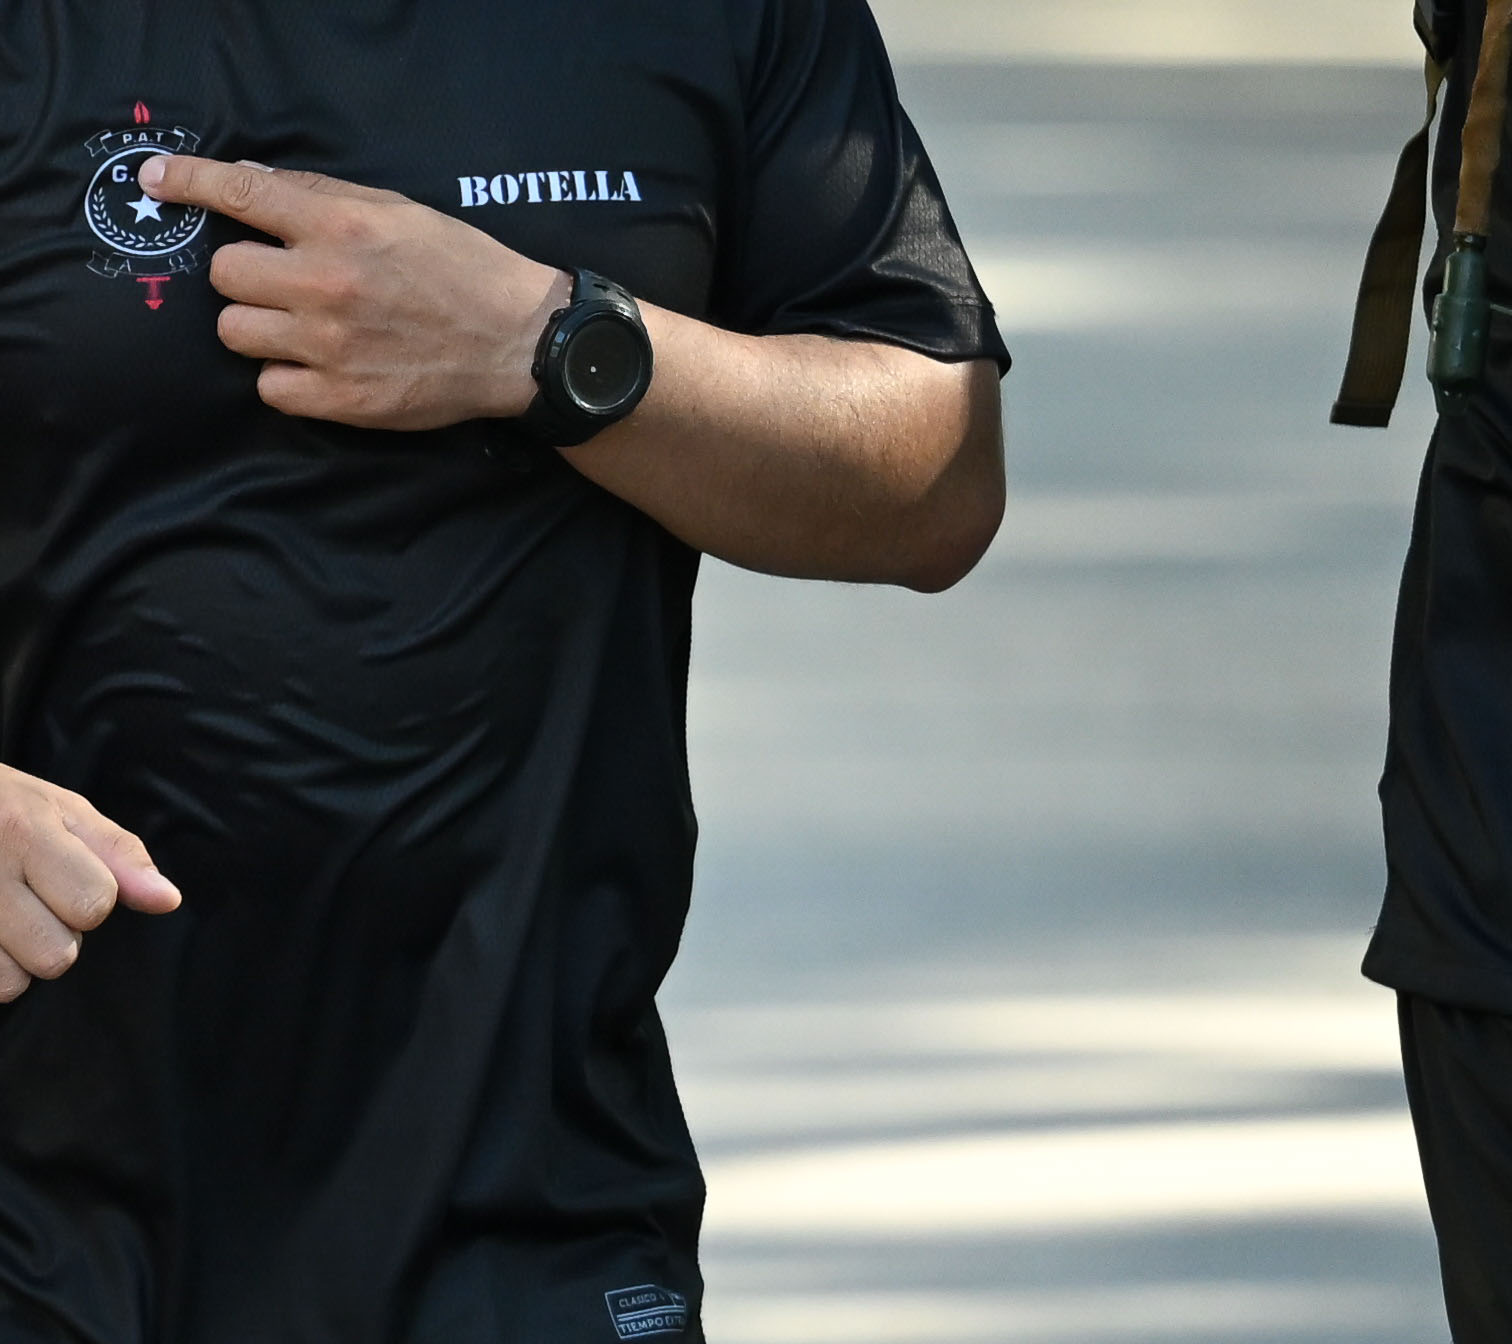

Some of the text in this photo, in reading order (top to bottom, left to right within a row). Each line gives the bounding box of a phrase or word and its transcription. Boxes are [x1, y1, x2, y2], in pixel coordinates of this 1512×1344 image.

[122, 132, 164, 145] P.A.T
[457, 170, 641, 208] BOTELLA
[617, 1317, 663, 1334] TIEMPO
